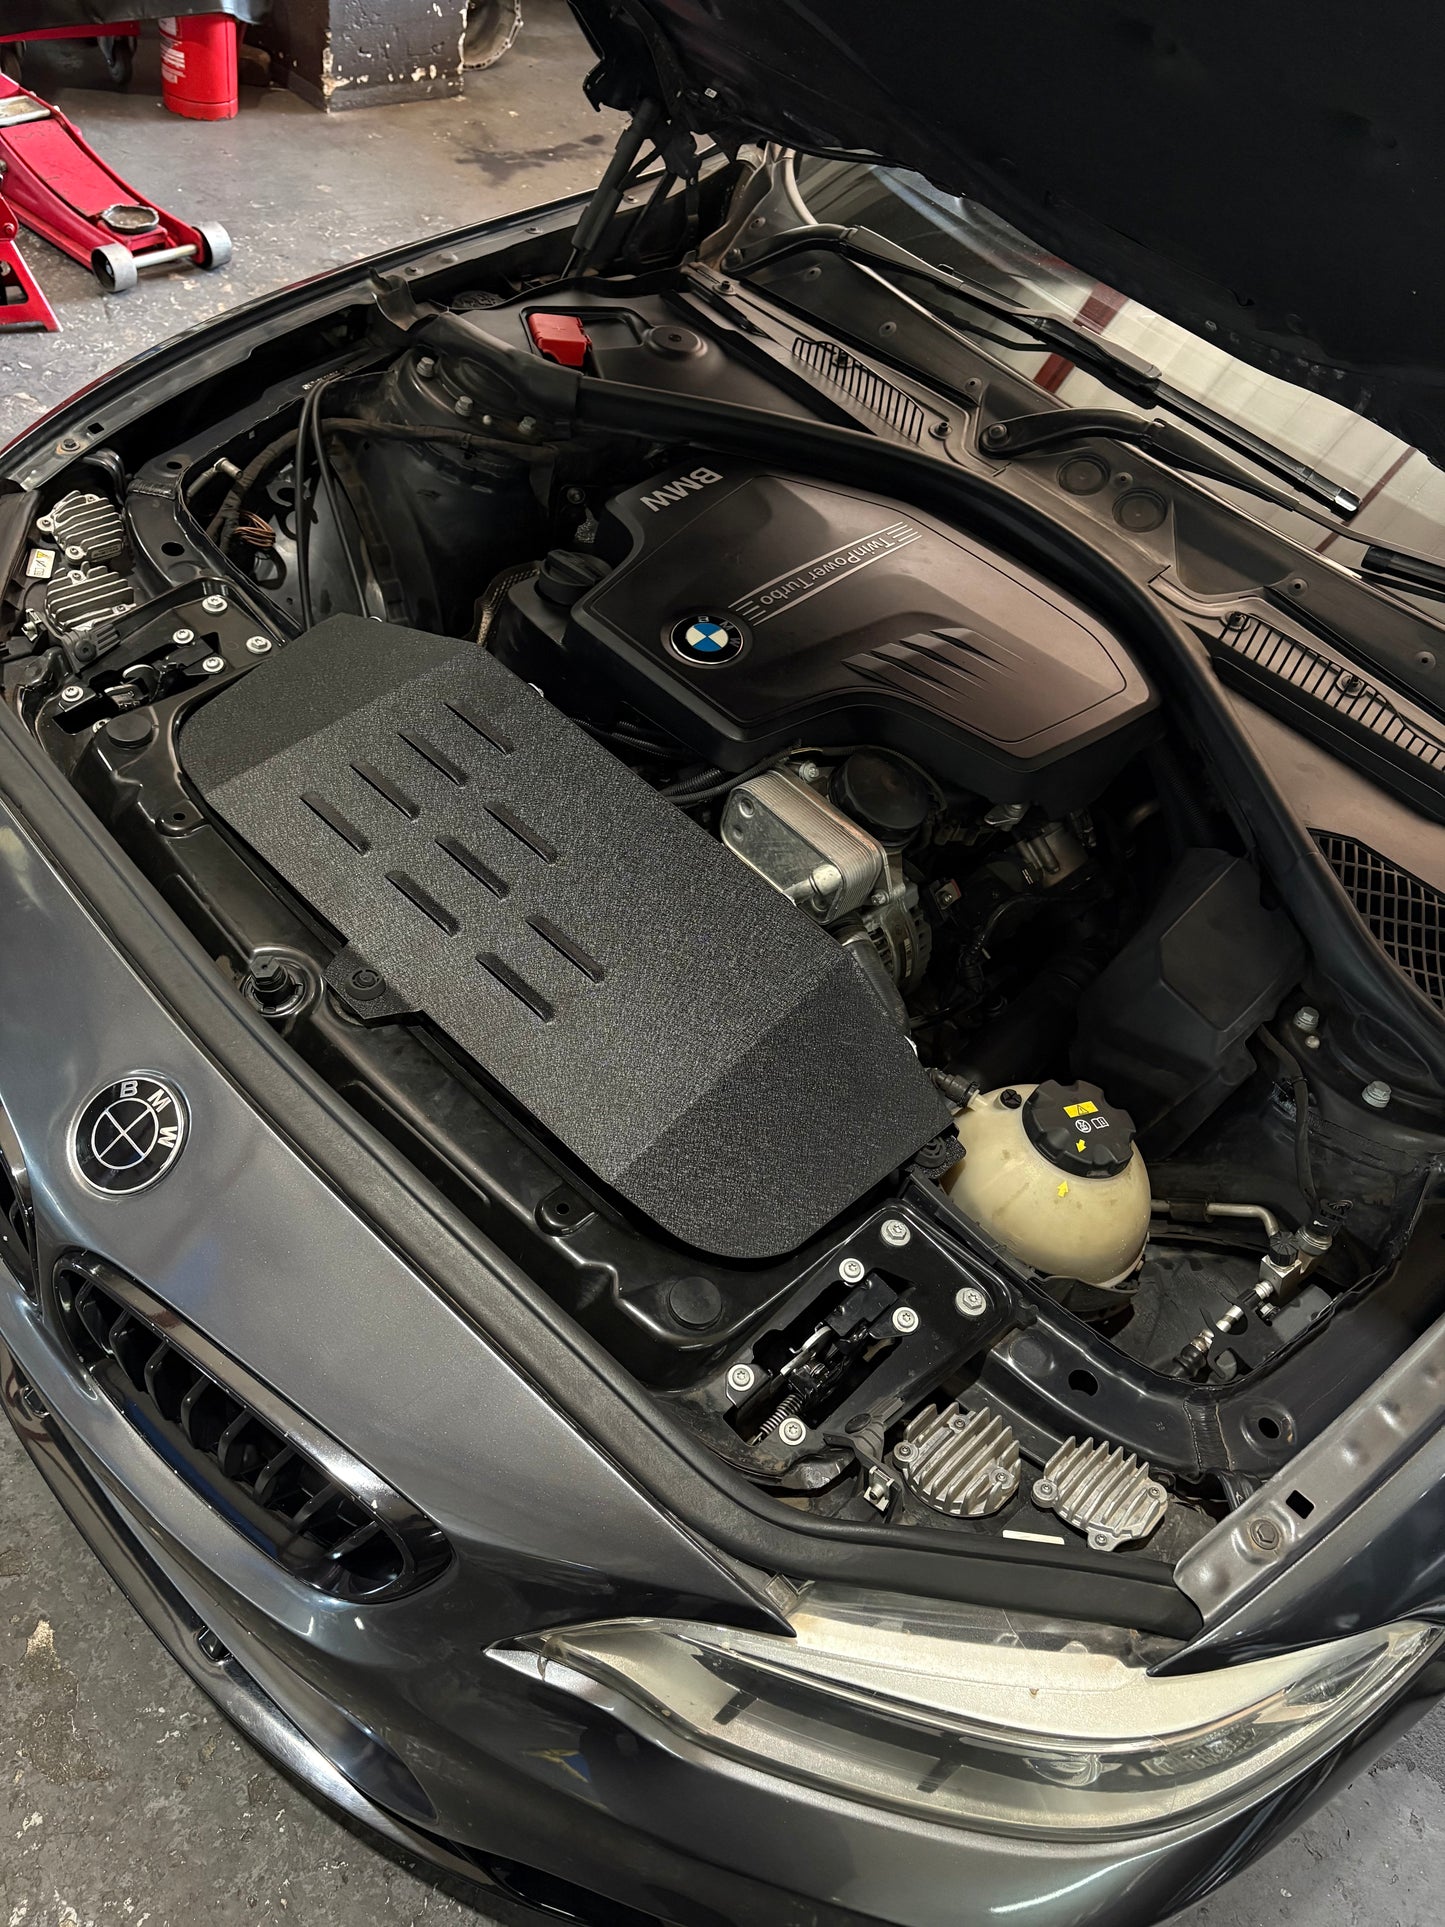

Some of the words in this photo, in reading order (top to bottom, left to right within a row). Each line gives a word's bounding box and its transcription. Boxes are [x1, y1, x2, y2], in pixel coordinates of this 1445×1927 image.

[640, 467, 723, 512] BMW
[697, 615, 740, 648] BMW
[120, 1080, 178, 1149] BMW
